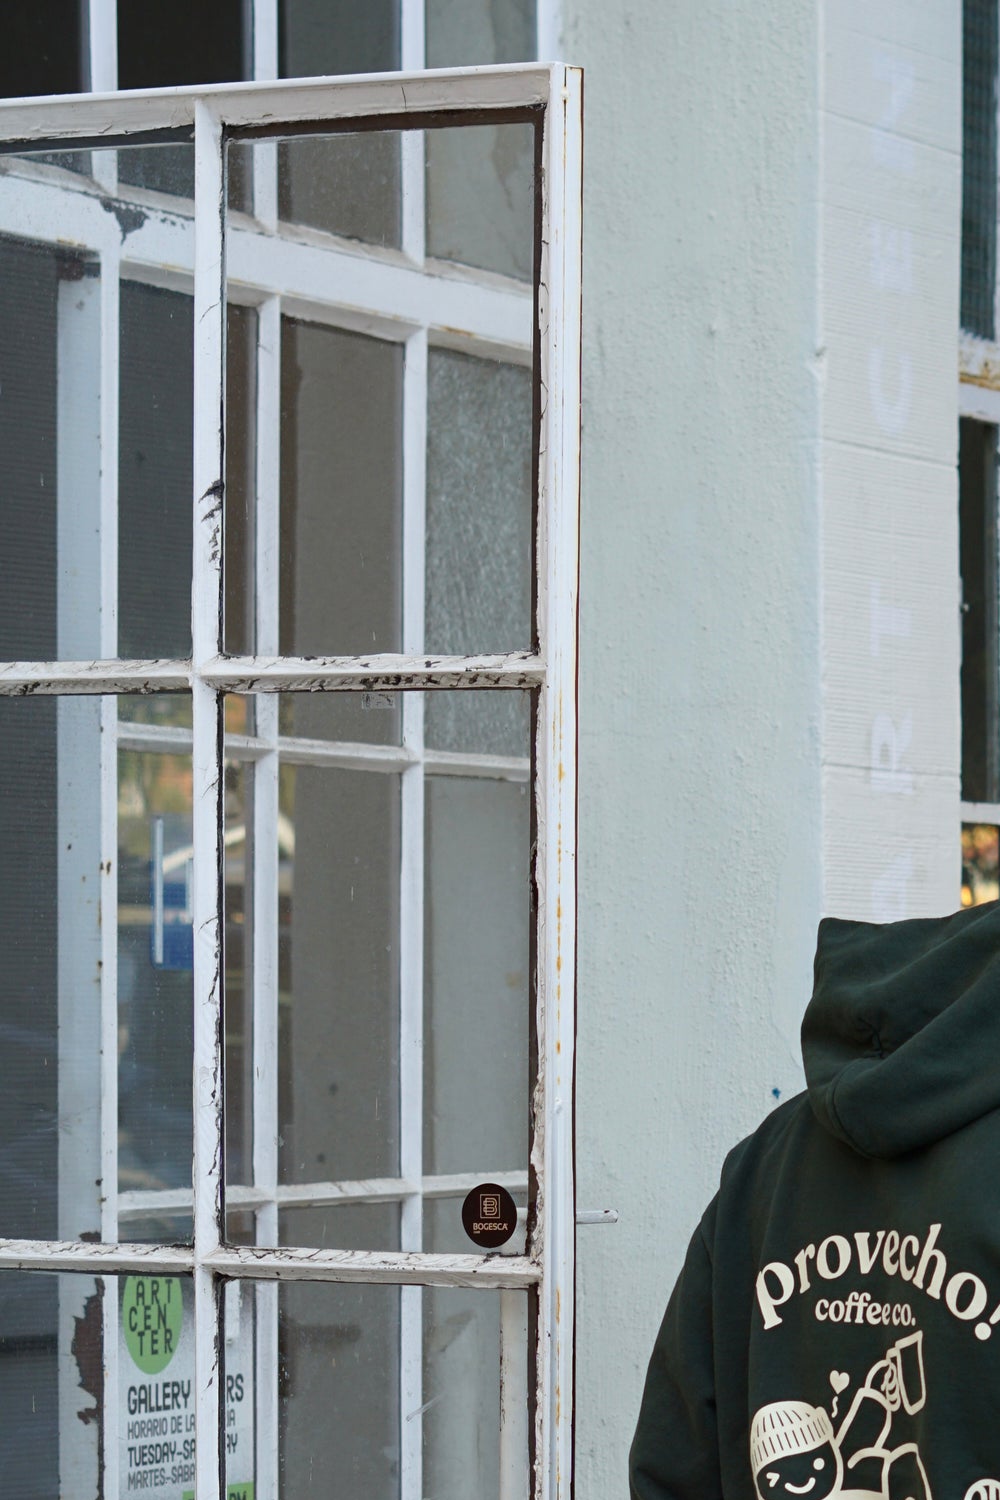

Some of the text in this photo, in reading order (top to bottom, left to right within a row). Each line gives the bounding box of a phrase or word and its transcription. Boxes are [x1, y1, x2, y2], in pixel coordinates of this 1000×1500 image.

[472, 1222, 508, 1231] BOGESCA
[136, 1279, 173, 1306] ART
[129, 1303, 167, 1332] CEN
[815, 1291, 916, 1326] coffee co.
[137, 1328, 173, 1356] TER
[127, 1379, 191, 1415] GALLERY
[128, 1413, 196, 1440] HORARIO DE LA
